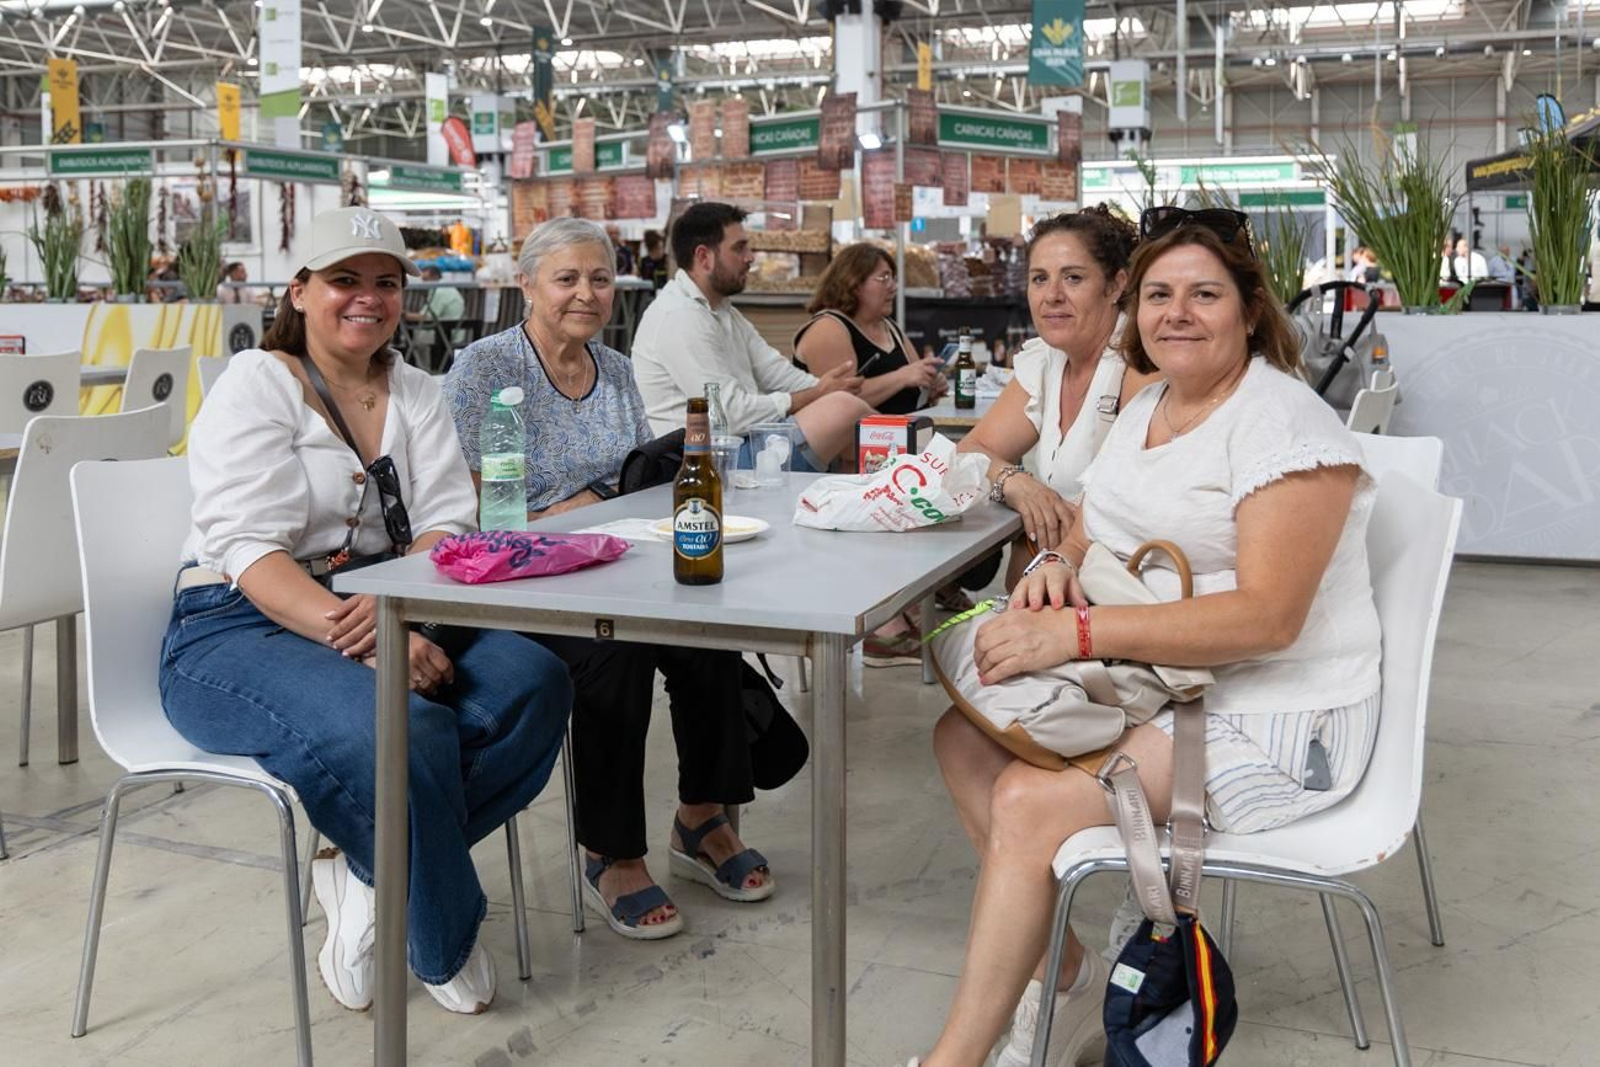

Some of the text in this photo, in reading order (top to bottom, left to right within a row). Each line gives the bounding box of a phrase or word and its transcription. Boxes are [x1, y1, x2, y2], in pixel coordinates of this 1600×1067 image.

[351, 214, 381, 238] NY
[678, 521, 717, 531] AMSTEL
[600, 622, 610, 636] 6
